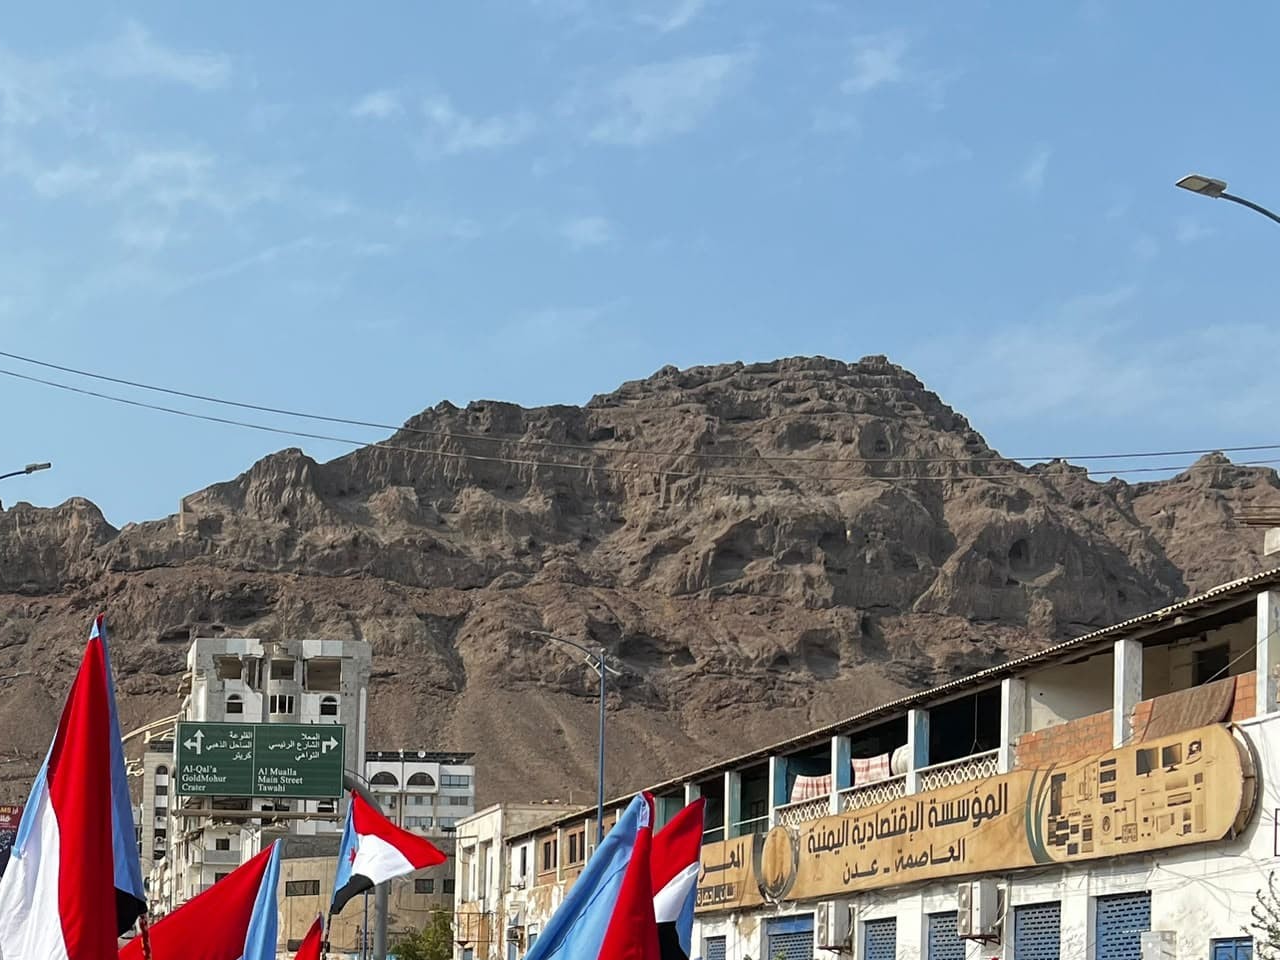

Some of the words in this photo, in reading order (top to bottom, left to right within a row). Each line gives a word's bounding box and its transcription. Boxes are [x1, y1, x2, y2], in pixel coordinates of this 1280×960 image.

[182, 774, 227, 783] GoldMohur
[257, 776, 278, 784] Main
[280, 776, 303, 785] Street
[258, 767, 269, 776] Al
[269, 768, 297, 776] Mualla
[182, 783, 206, 792] Crater
[257, 784, 286, 792] Tawahi
[927, 782, 1009, 828] المؤسسة
[852, 801, 924, 850] الإقتصادية
[808, 819, 849, 858] اليمنية
[894, 838, 966, 873] العاصمة
[842, 858, 879, 885] عدن
